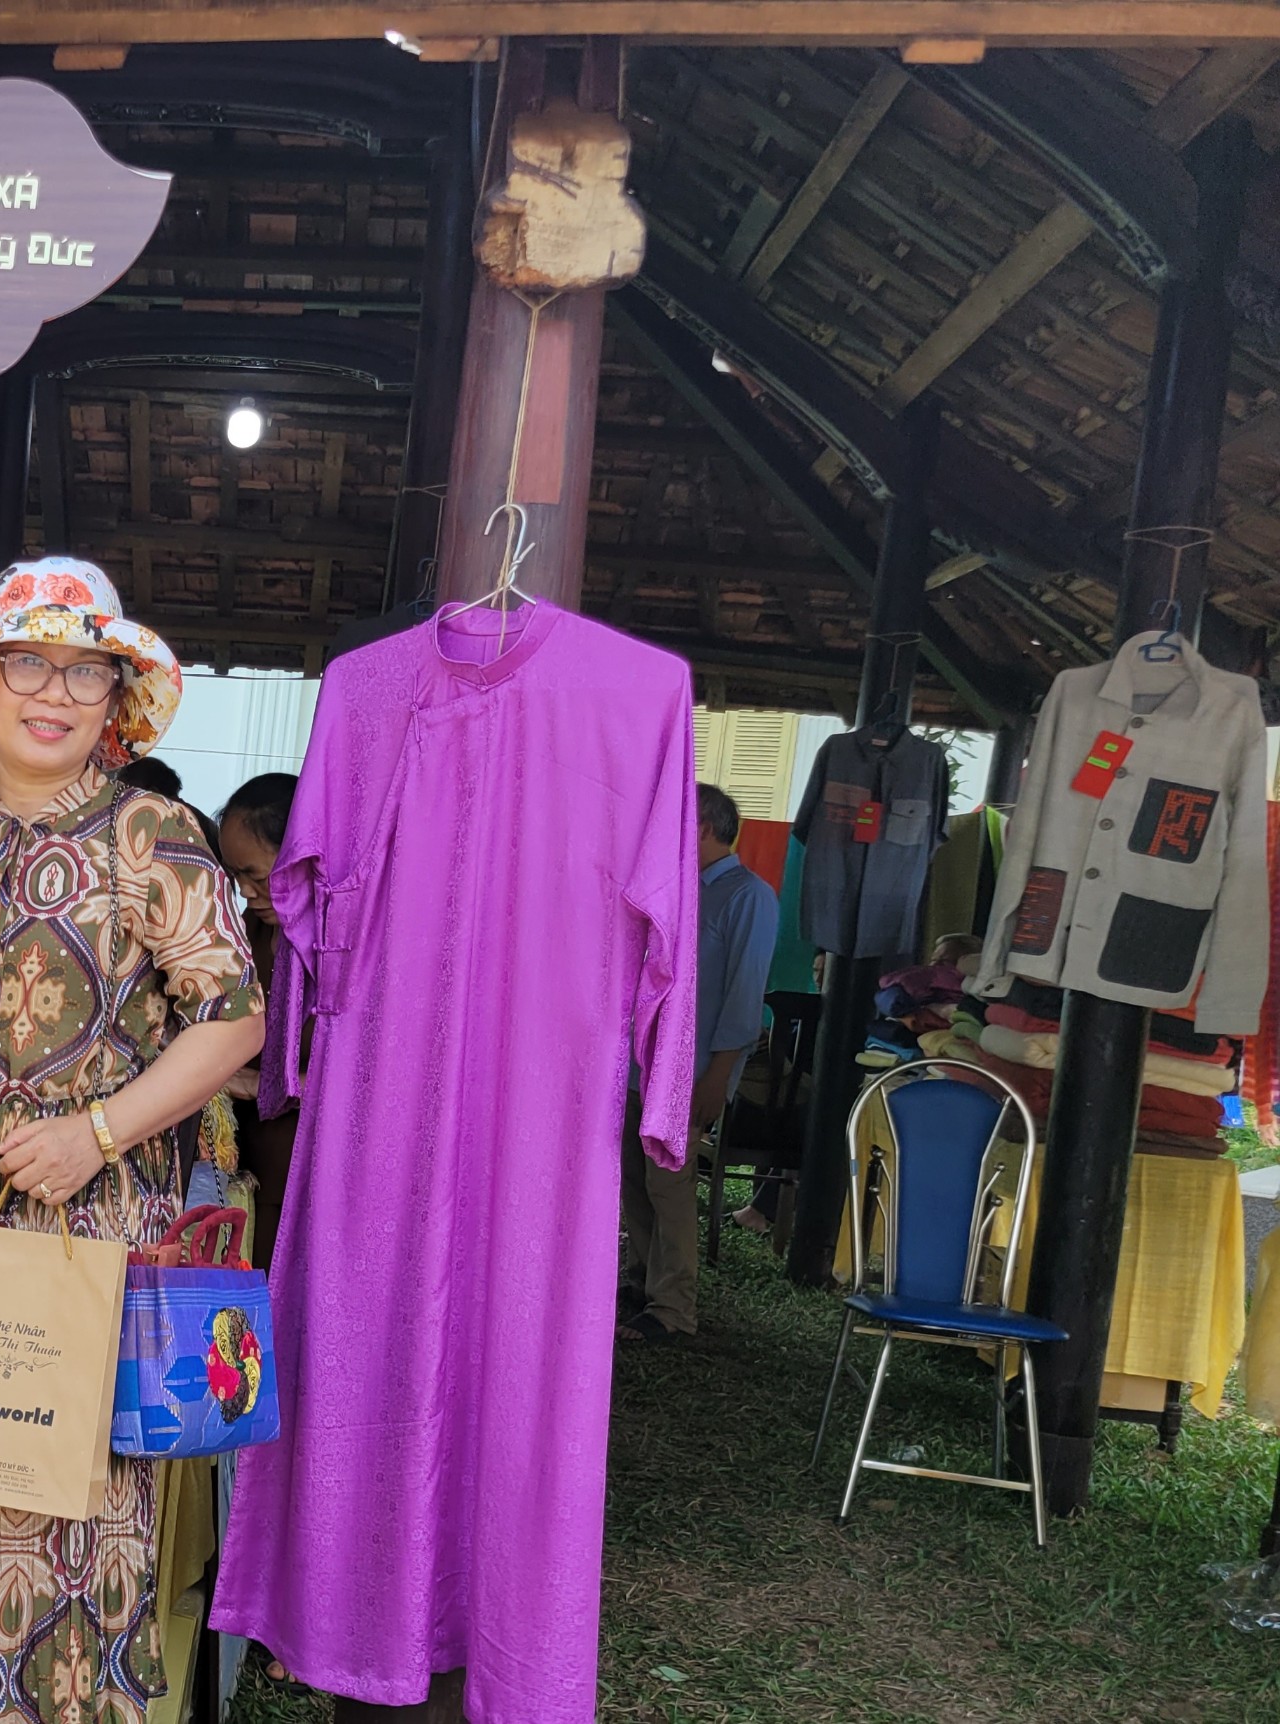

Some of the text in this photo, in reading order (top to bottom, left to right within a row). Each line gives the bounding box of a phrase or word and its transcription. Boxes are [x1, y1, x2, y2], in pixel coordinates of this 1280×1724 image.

[27, 233, 95, 267] Đức
[14, 1322, 46, 1338] Nhân
[24, 1341, 62, 1358] Thuận
